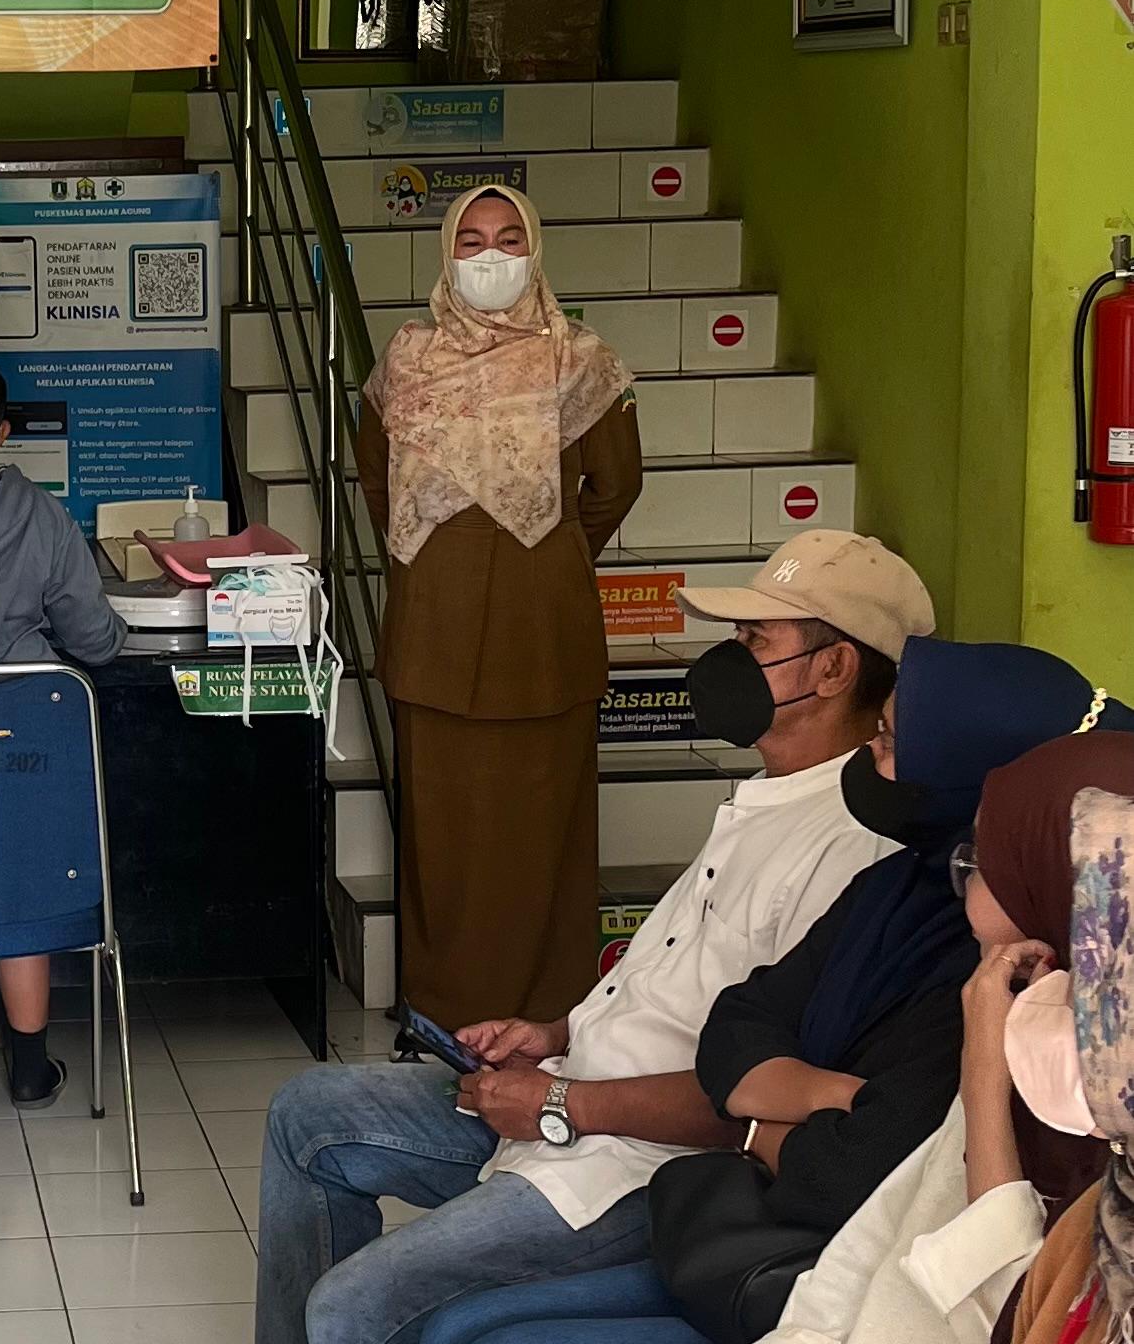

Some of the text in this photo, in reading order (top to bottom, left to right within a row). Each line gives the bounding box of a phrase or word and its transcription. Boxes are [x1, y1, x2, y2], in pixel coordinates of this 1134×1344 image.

[411, 96, 499, 116] Sasaran 6
[431, 167, 523, 189] Sasaran 5
[34, 207, 151, 218] PUSKESMAS BANJAR AGUNG
[46, 242, 117, 252] PENDAFTARAN
[46, 255, 81, 264] ONLINE
[47, 266, 115, 276] PASIEN UMUM
[47, 277, 115, 287] LEBIH PRAKTIS
[47, 290, 89, 300] DENGAN
[46, 305, 120, 321] KLINISIA
[106, 362, 173, 372] PENDAFTARAN
[36, 377, 155, 388] MELALUI APLIKASI KLINISIA
[177, 405, 195, 416] App
[195, 405, 216, 414] Store
[98, 419, 116, 430] Play
[599, 586, 659, 603] saran
[600, 688, 691, 709] Sasaran
